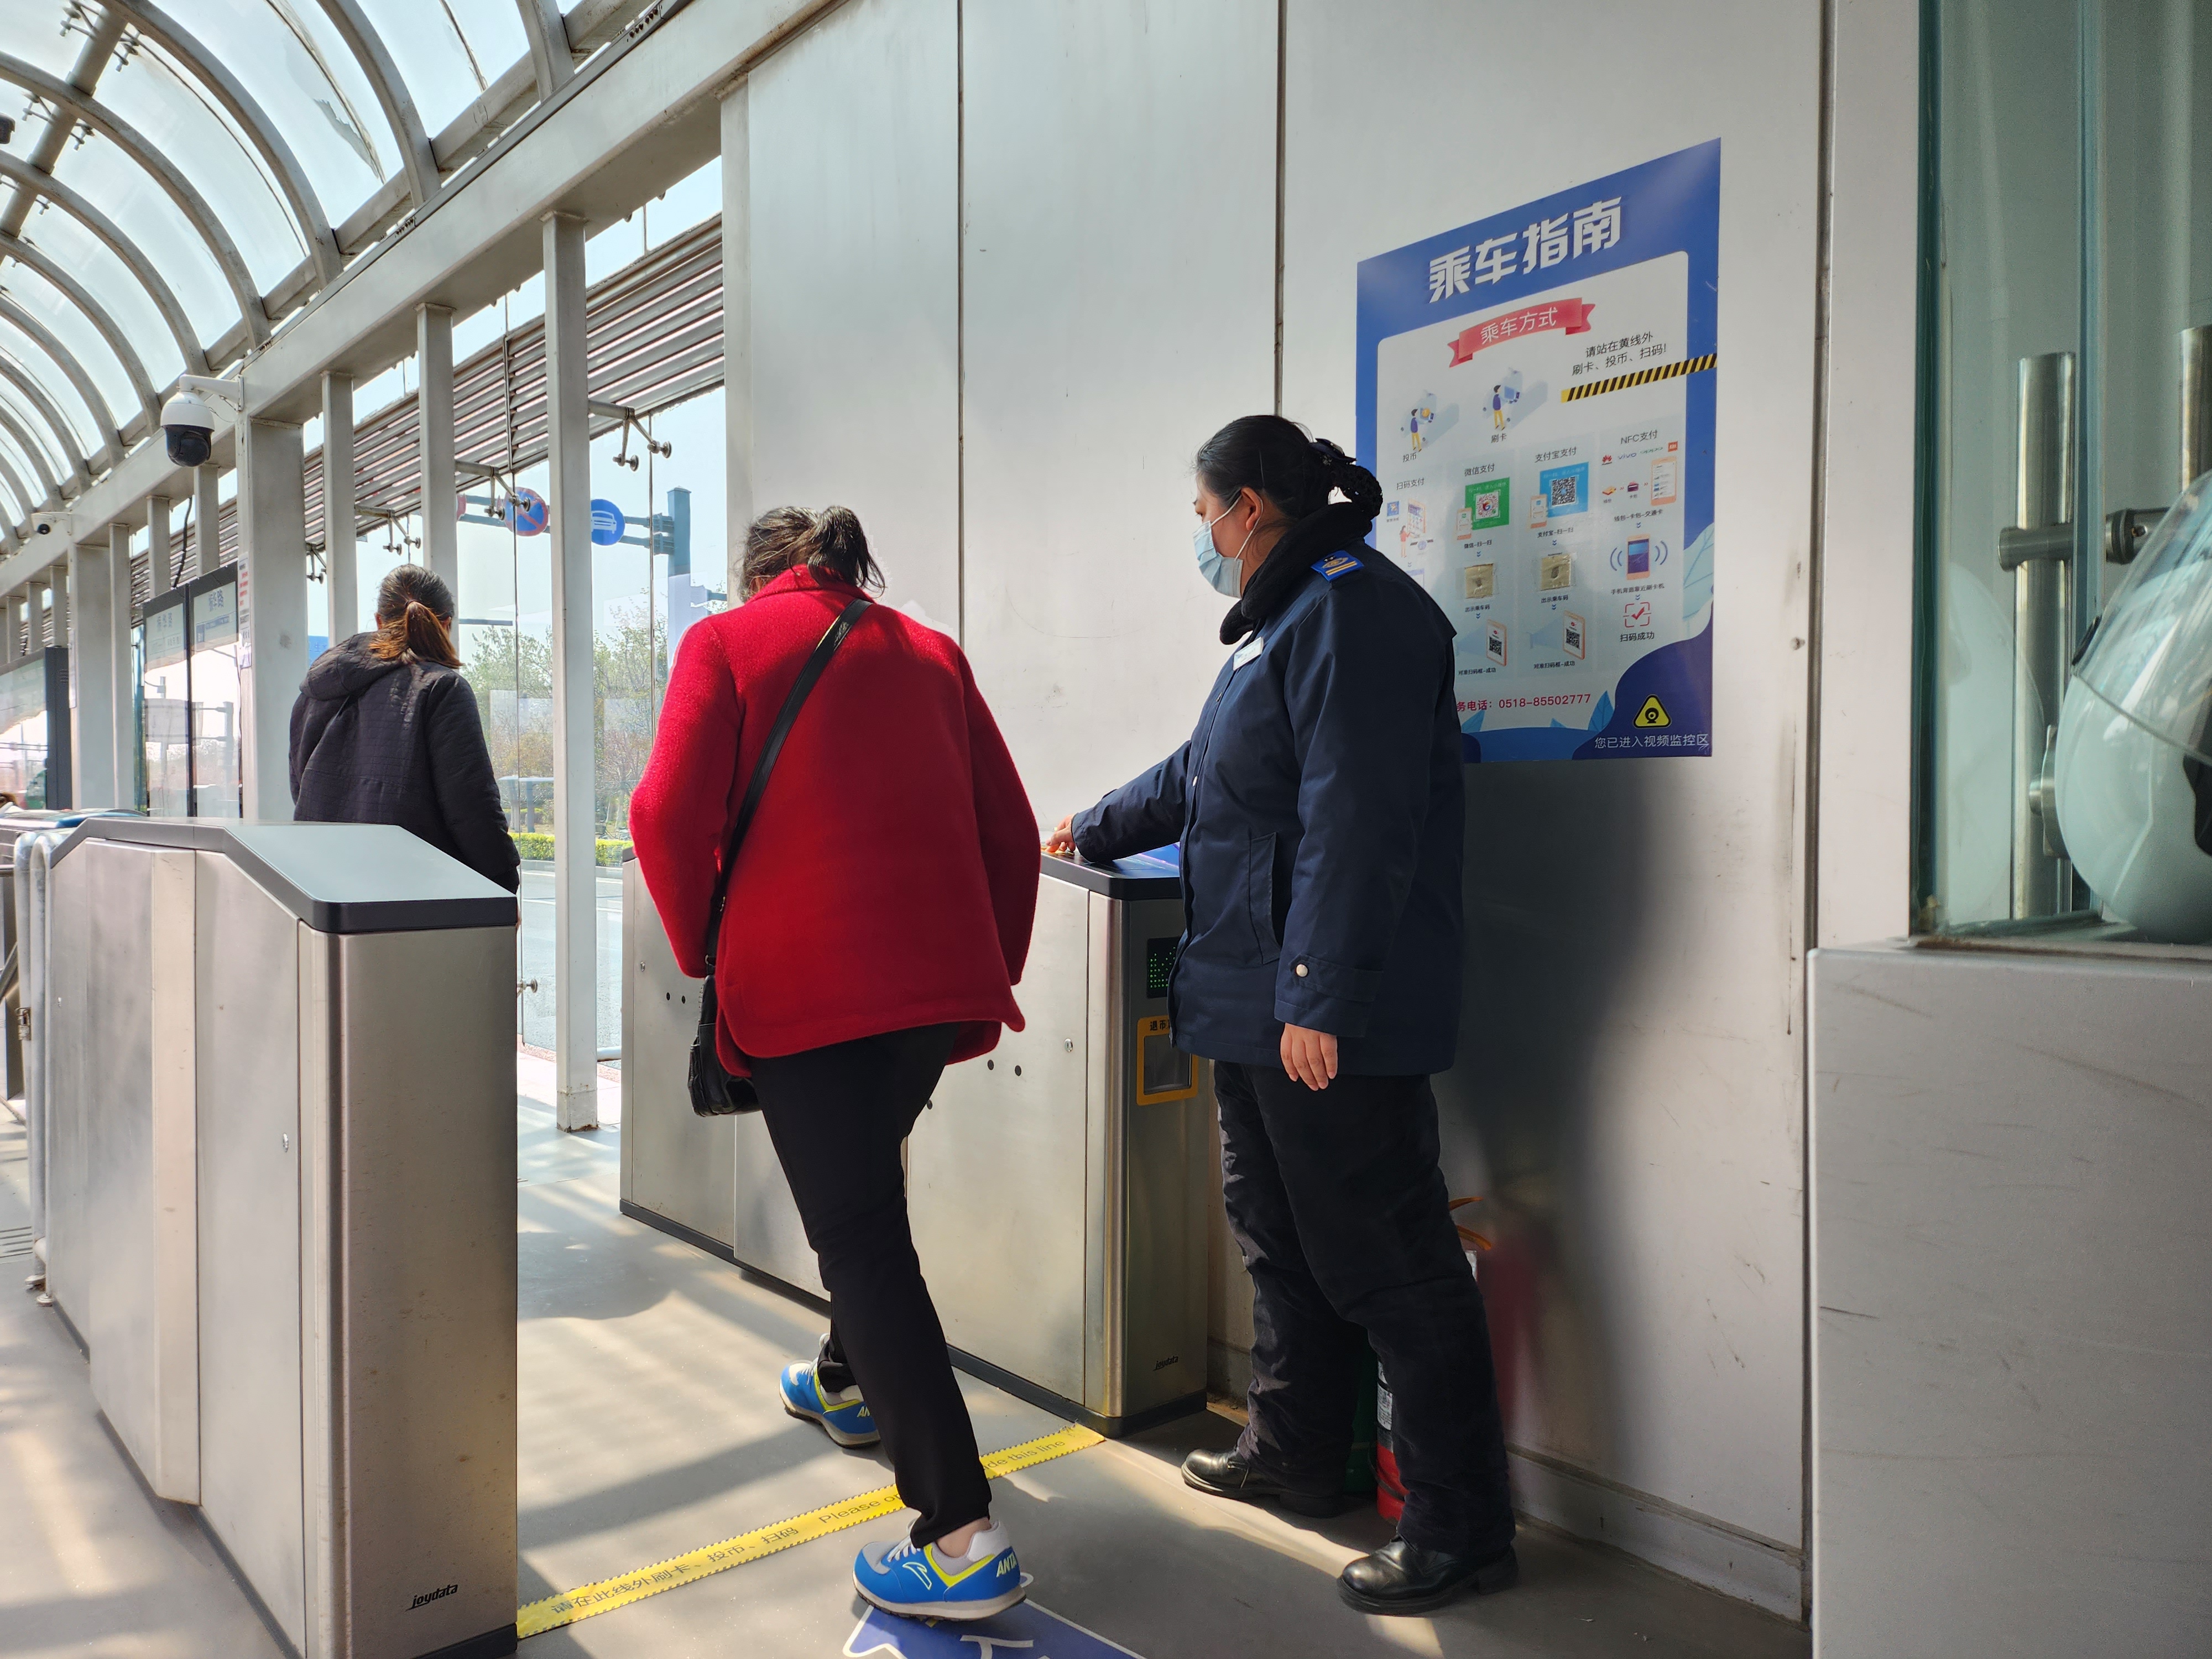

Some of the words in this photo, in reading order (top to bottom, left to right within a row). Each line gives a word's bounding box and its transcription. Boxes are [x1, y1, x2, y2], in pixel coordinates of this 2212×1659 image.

[1428, 197, 1623, 304] 乘车指南
[1481, 306, 1558, 345] 乘车方式
[1585, 332, 1653, 358] 请站在黄线外
[1490, 434, 1507, 444] 刷卡
[1621, 430, 1658, 444] NFC支付
[1402, 453, 1417, 463] 投币
[1535, 447, 1577, 463] 支付宝支付
[1464, 463, 1495, 476] 微信支付
[1396, 478, 1425, 490] 扫码支付
[1620, 632, 1655, 642] 扫码成功
[1457, 694, 1591, 712] 务电话：0518-85502777
[1594, 734, 1709, 749] 您已进入视频监控区
[818, 1500, 881, 1525] Please
[1036, 1441, 1066, 1452] line
[551, 1527, 799, 1614] 请在此线外刷卡、投币、扫码
[405, 1584, 458, 1612] joydata
